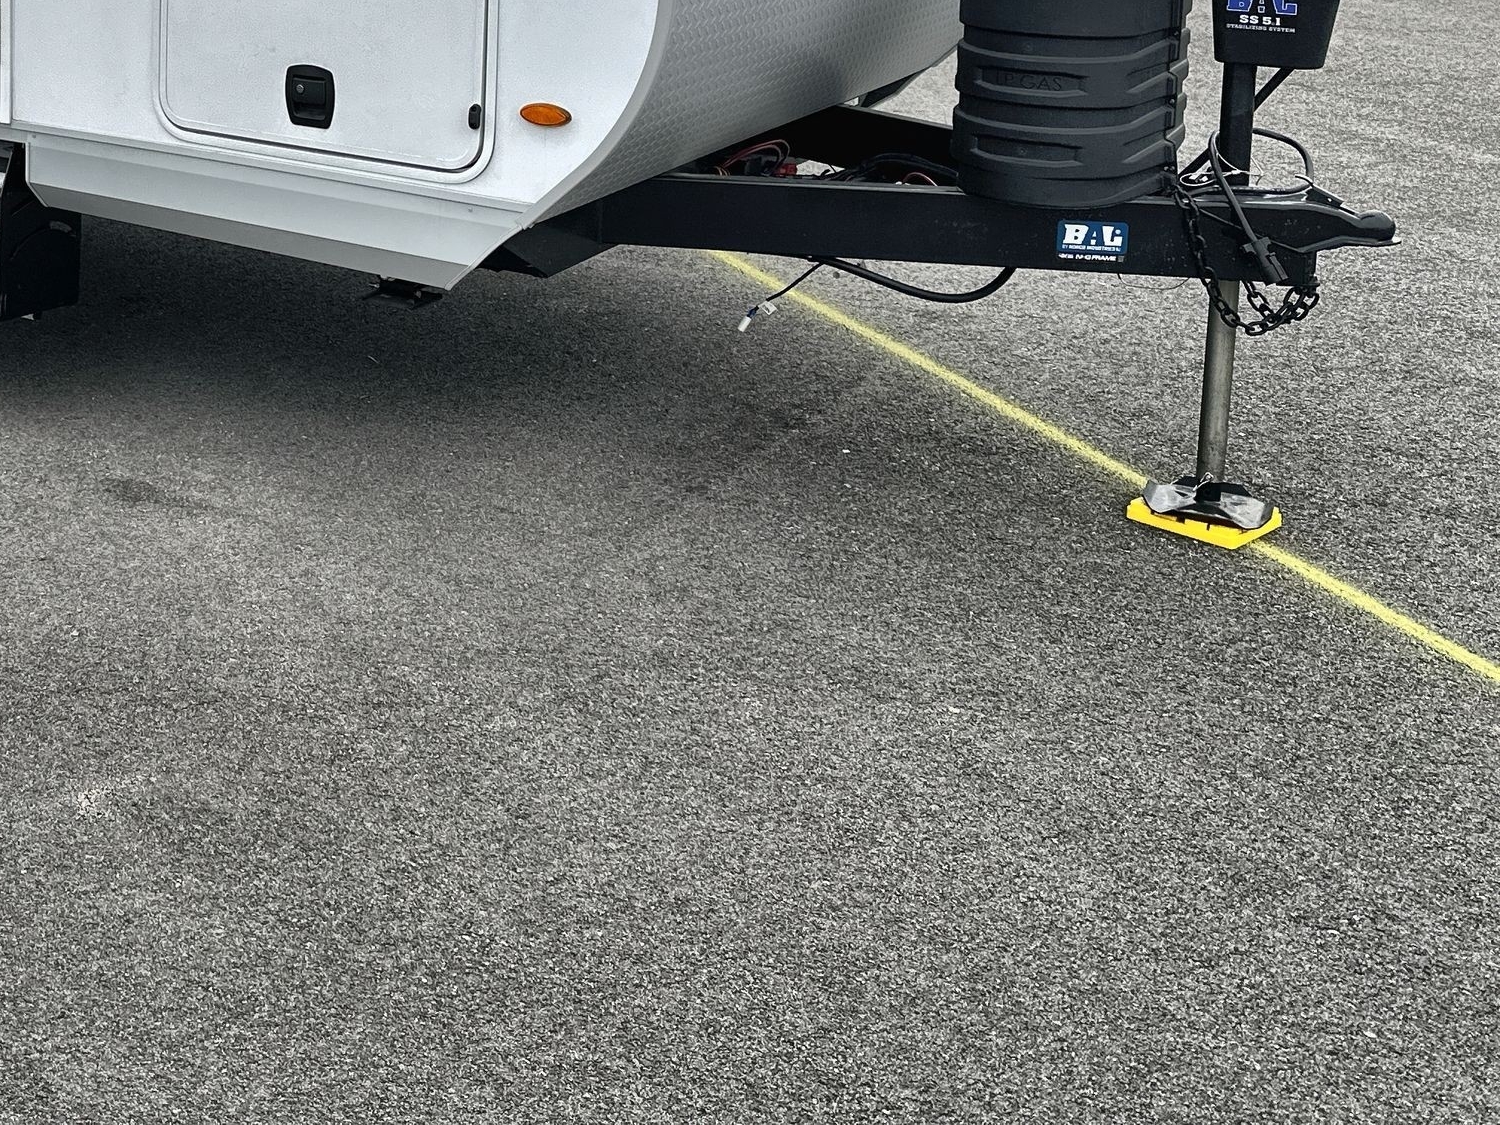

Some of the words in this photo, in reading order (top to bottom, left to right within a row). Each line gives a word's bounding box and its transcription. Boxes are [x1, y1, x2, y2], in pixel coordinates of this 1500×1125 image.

[1239, 14, 1259, 24] SS
[1019, 74, 1063, 92] GAS
[1062, 223, 1123, 247] BAL
